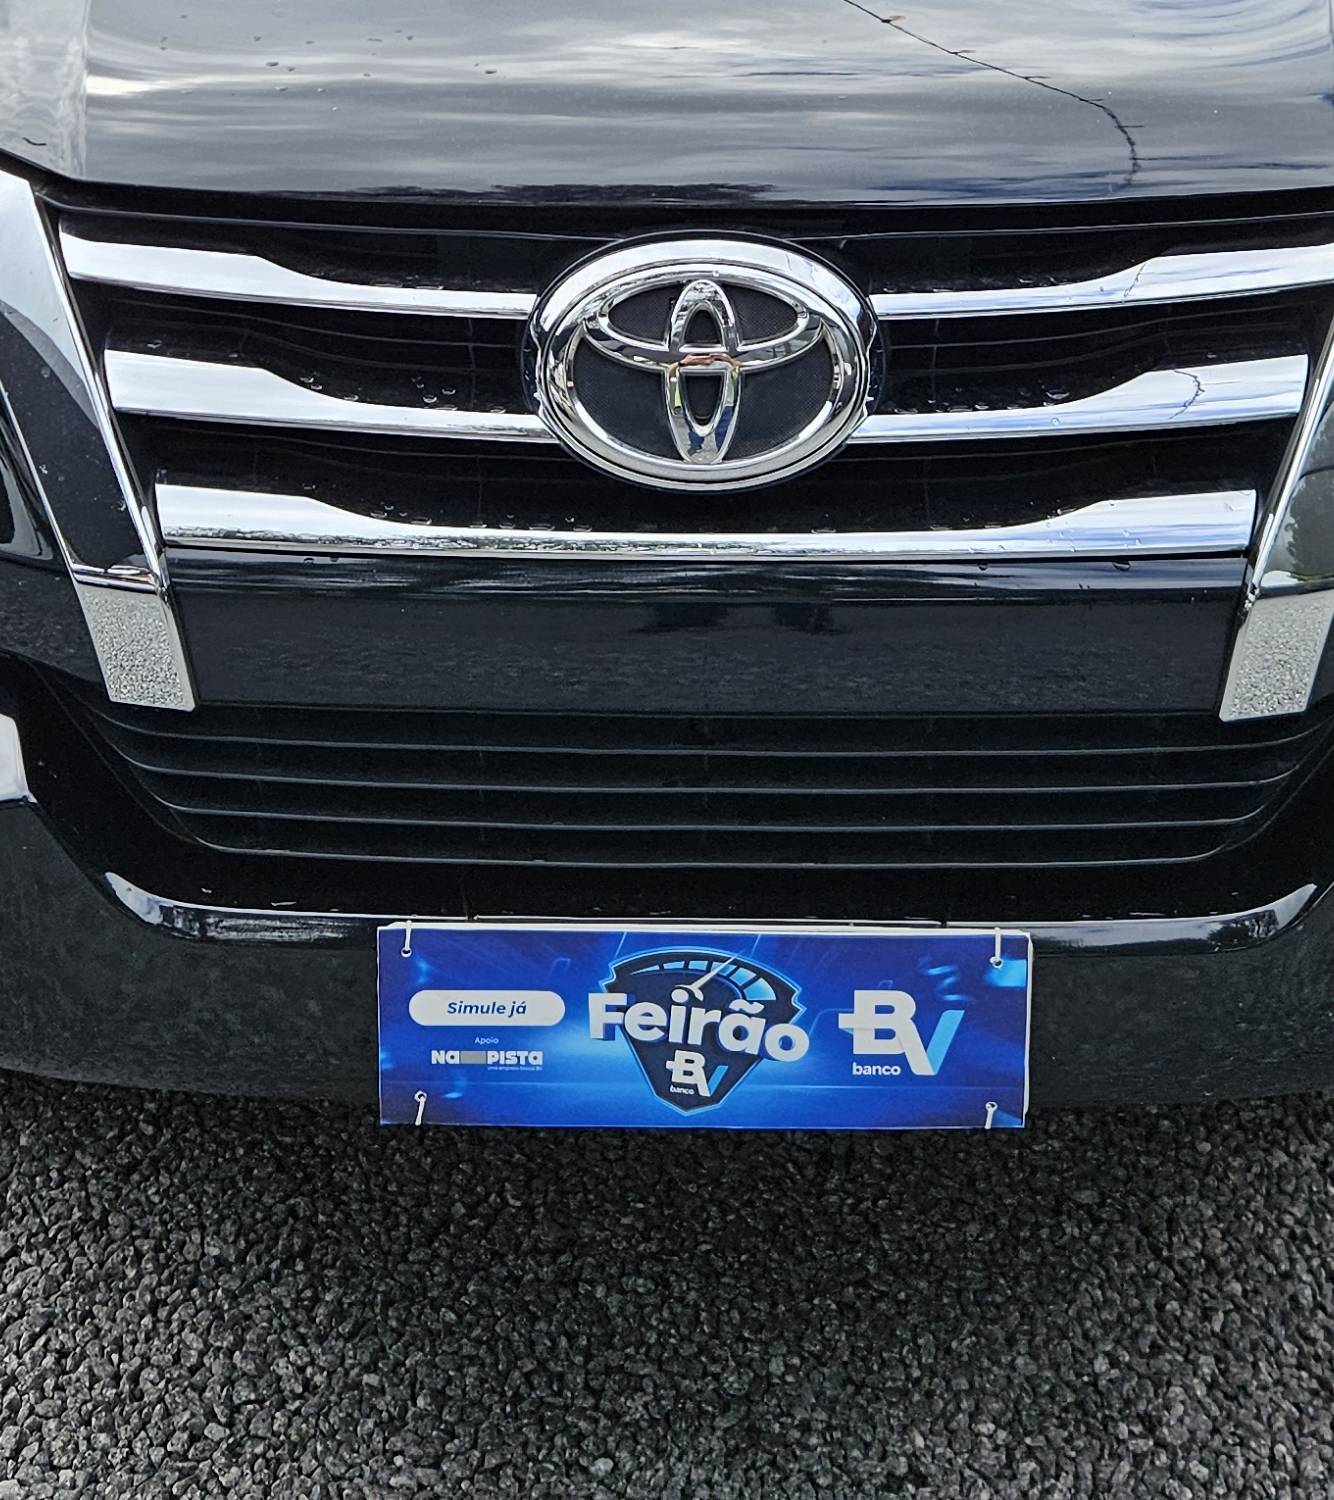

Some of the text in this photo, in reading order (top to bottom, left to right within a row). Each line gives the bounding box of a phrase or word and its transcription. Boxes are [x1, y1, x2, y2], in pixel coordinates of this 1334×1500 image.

[447, 1001, 527, 1019] Simule já
[588, 988, 809, 1063] Feirão
[838, 989, 965, 1076] BV
[474, 1036, 499, 1045] Apoio
[666, 1049, 729, 1097] BV
[852, 1062, 902, 1076] banco
[669, 1084, 695, 1096] banco
